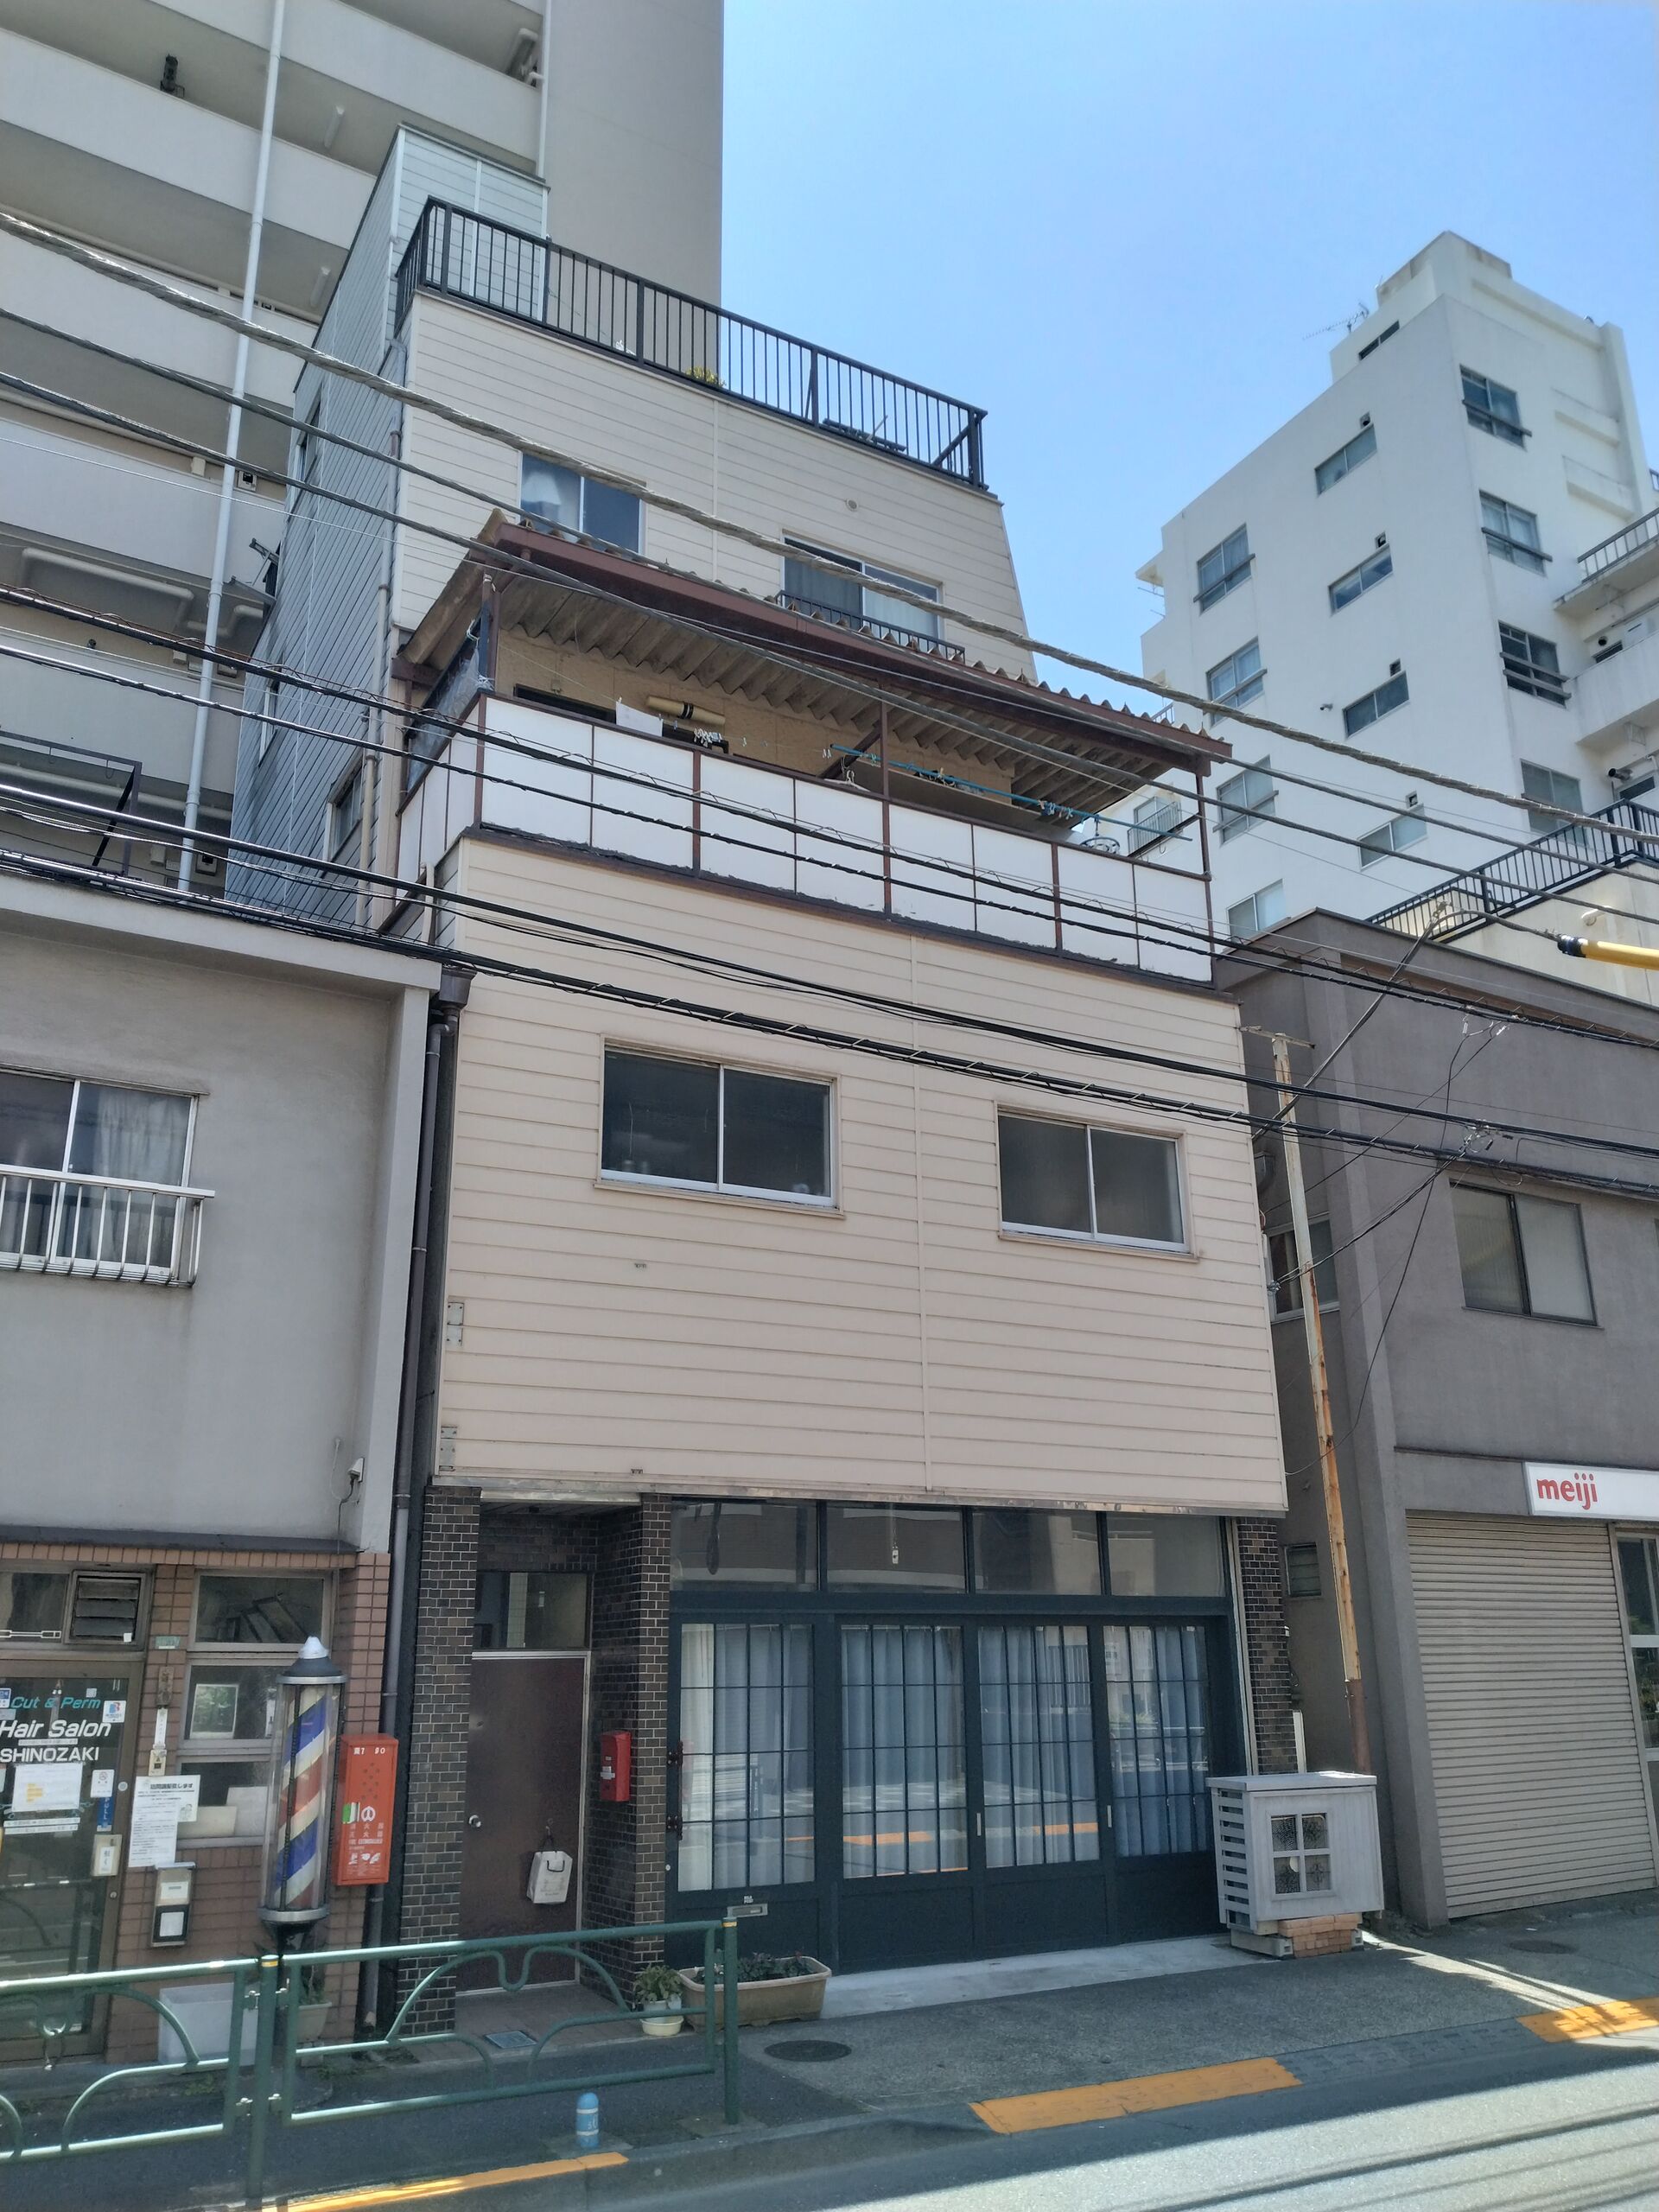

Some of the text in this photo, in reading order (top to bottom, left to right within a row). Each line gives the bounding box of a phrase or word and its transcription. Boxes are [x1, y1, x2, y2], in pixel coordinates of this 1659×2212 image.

[1536, 1472, 1598, 1510] meiji
[10, 1696, 41, 1709] Cut
[44, 1697, 57, 1708] &
[60, 1696, 101, 1709] Perm
[0, 1719, 111, 1738] Hair Salon
[0, 1746, 99, 1763] SHINOZAKI
